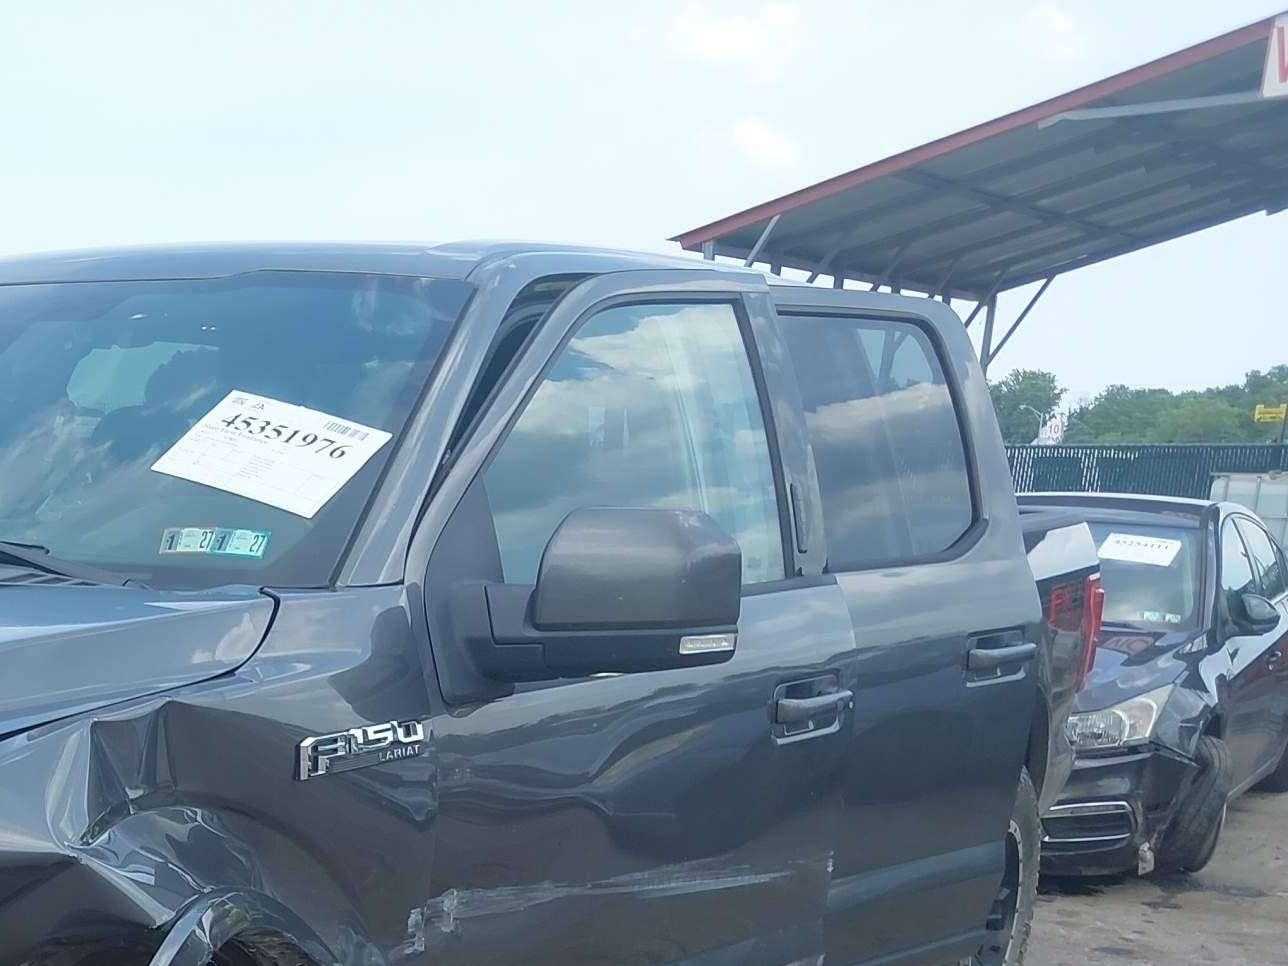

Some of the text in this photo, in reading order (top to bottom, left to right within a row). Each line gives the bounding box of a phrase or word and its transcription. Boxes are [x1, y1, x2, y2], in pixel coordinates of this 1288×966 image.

[221, 412, 354, 459] 45351976
[199, 530, 215, 551] 27
[248, 534, 266, 554] 27
[378, 744, 421, 761] LARIAT
